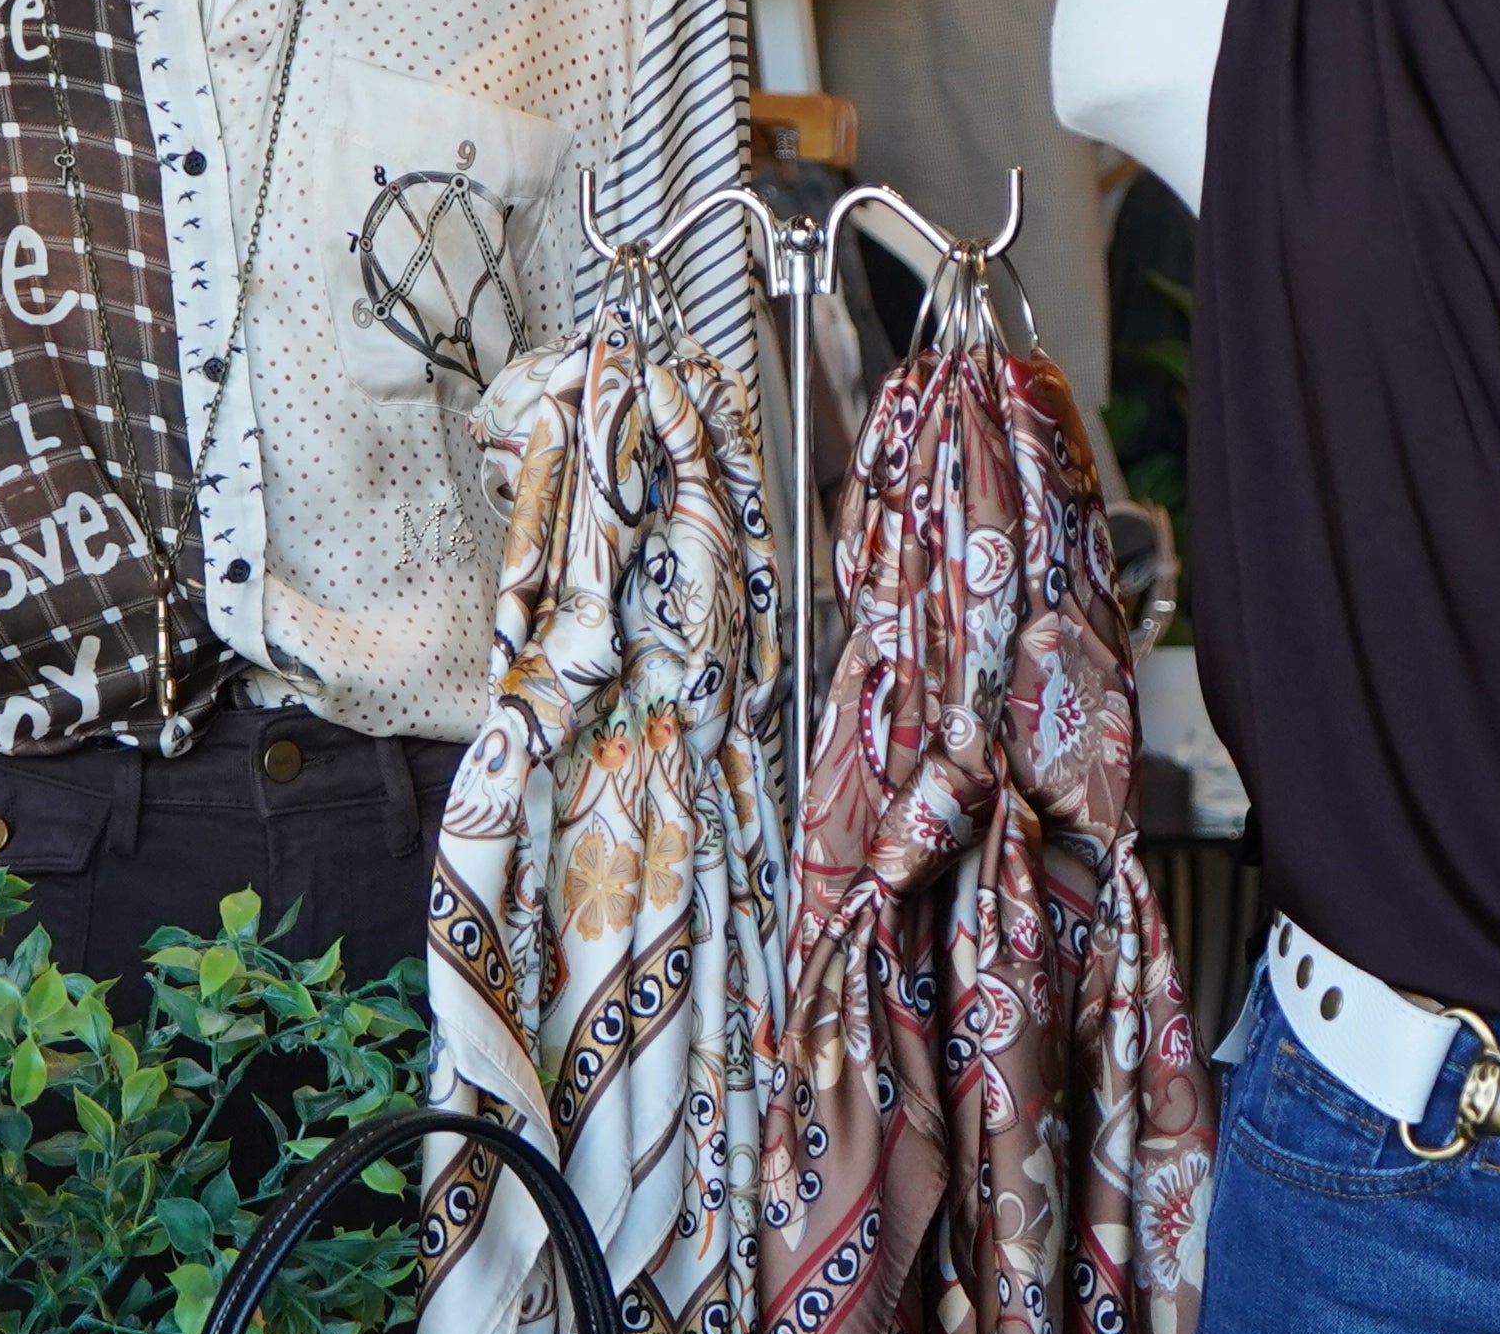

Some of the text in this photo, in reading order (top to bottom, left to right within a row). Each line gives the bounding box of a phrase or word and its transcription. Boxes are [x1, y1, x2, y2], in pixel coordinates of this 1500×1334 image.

[457, 140, 477, 171] 9
[373, 165, 387, 187] 8
[346, 232, 359, 253] 7
[352, 298, 373, 328] 6
[425, 362, 435, 384] 5
